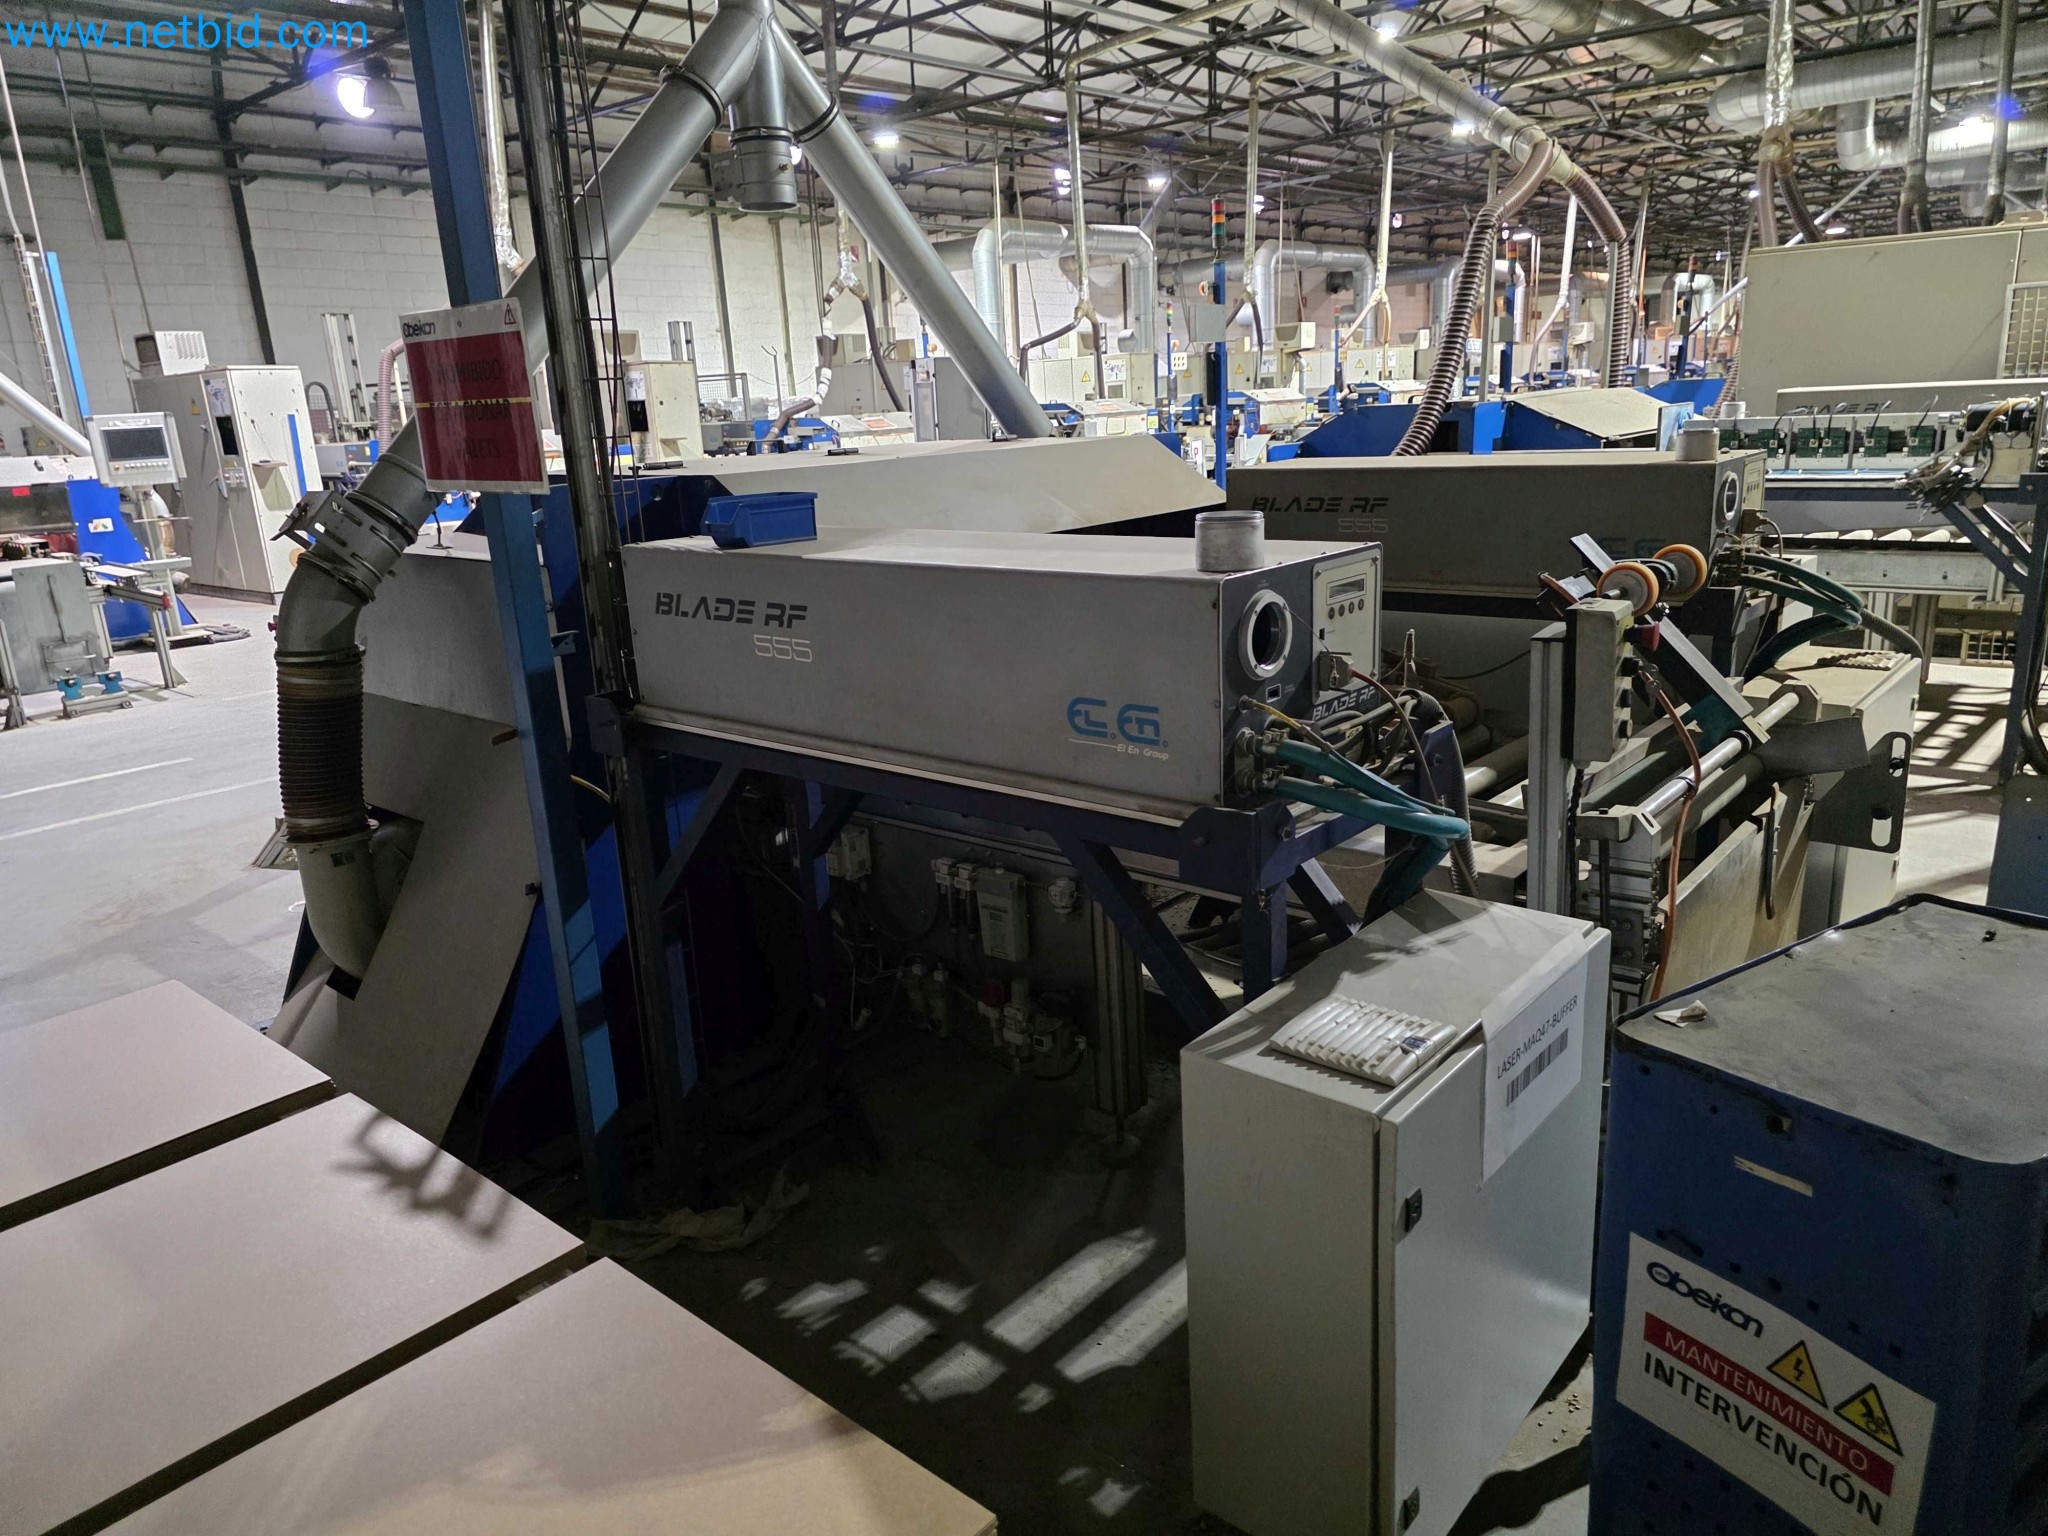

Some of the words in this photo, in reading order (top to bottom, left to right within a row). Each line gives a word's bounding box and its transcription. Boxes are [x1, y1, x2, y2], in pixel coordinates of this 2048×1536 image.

[1251, 496, 1343, 513] BLADE
[1349, 496, 1389, 513] RF
[655, 592, 756, 624] BLADE
[763, 602, 808, 629] RF
[753, 634, 813, 662] 555
[1312, 692, 1357, 721] BLADE
[1143, 748, 1169, 760] Group
[1665, 1331, 1868, 1472] MANTENIMIENTO
[1644, 1351, 1883, 1527] INTERVENCIÓN
